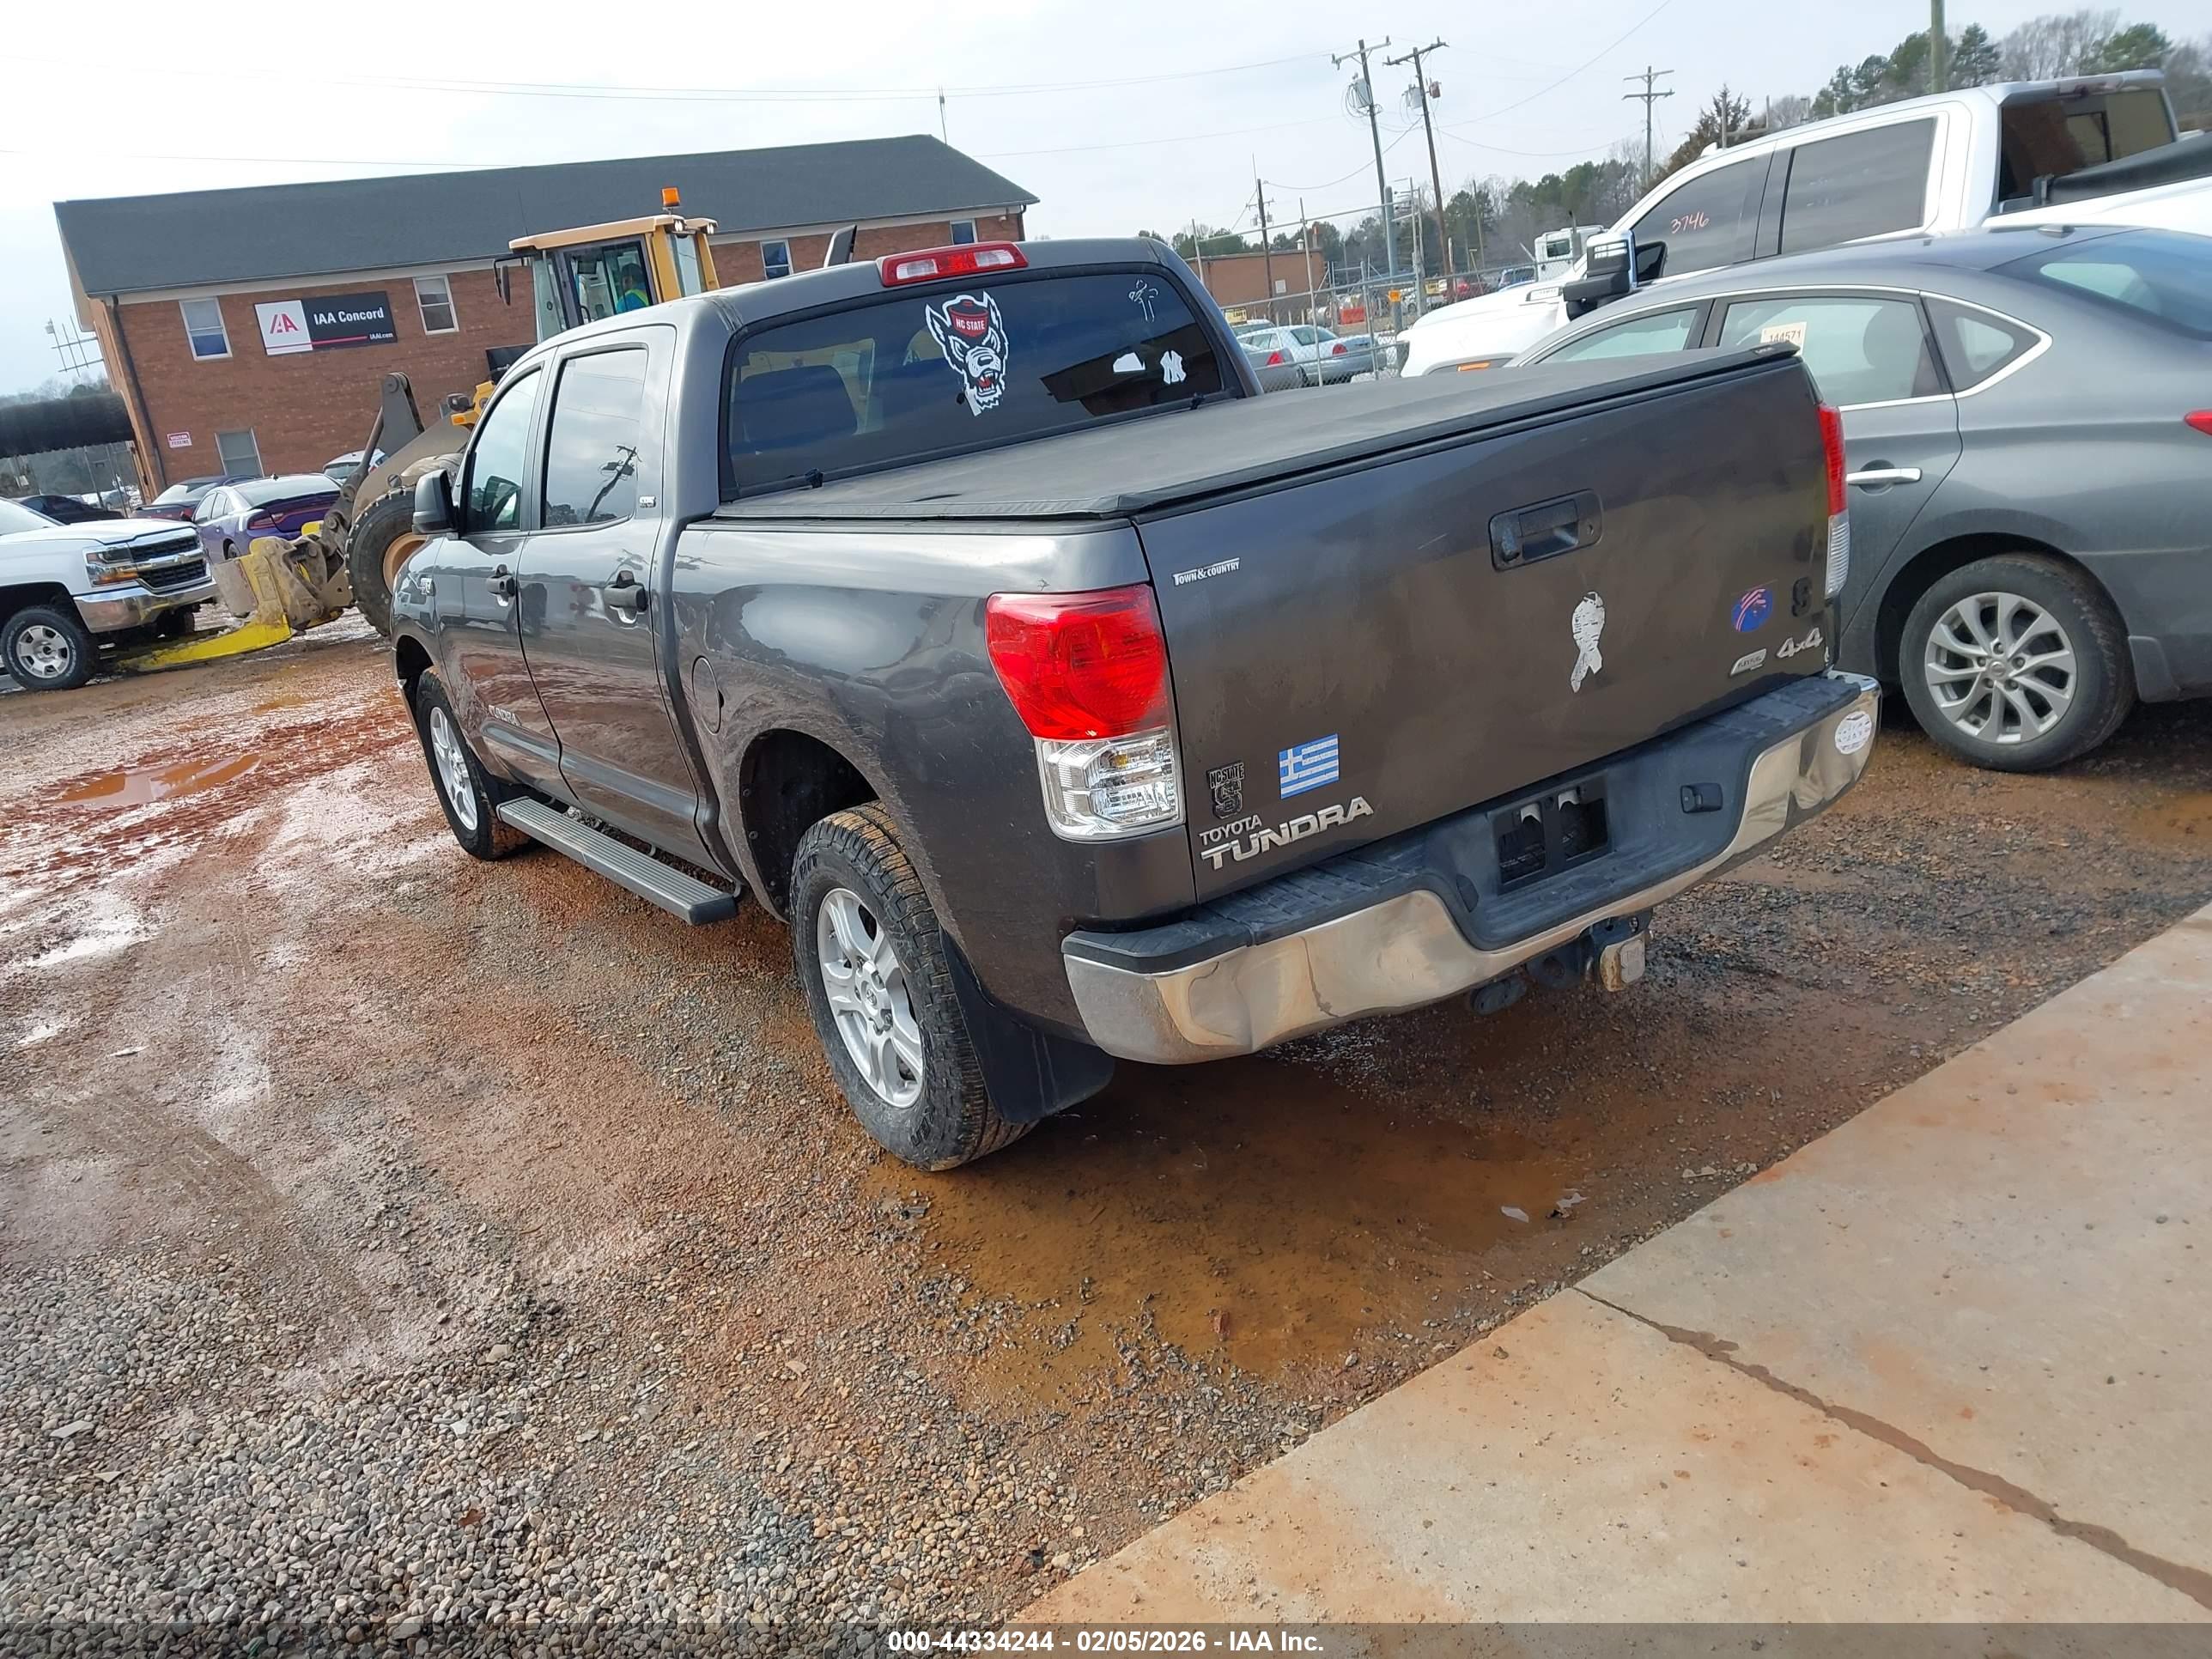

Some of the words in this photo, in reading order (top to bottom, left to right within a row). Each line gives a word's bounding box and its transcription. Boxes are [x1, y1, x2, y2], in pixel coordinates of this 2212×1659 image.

[1671, 211, 1710, 234] 3746
[313, 312, 337, 325] IAA
[338, 307, 385, 322] Concord
[956, 318, 966, 330] NC
[966, 319, 986, 331] STATE
[1777, 627, 1824, 659] 4x4
[1200, 814, 1263, 846] TOYOTA
[1200, 796, 1374, 871] TUNDRA
